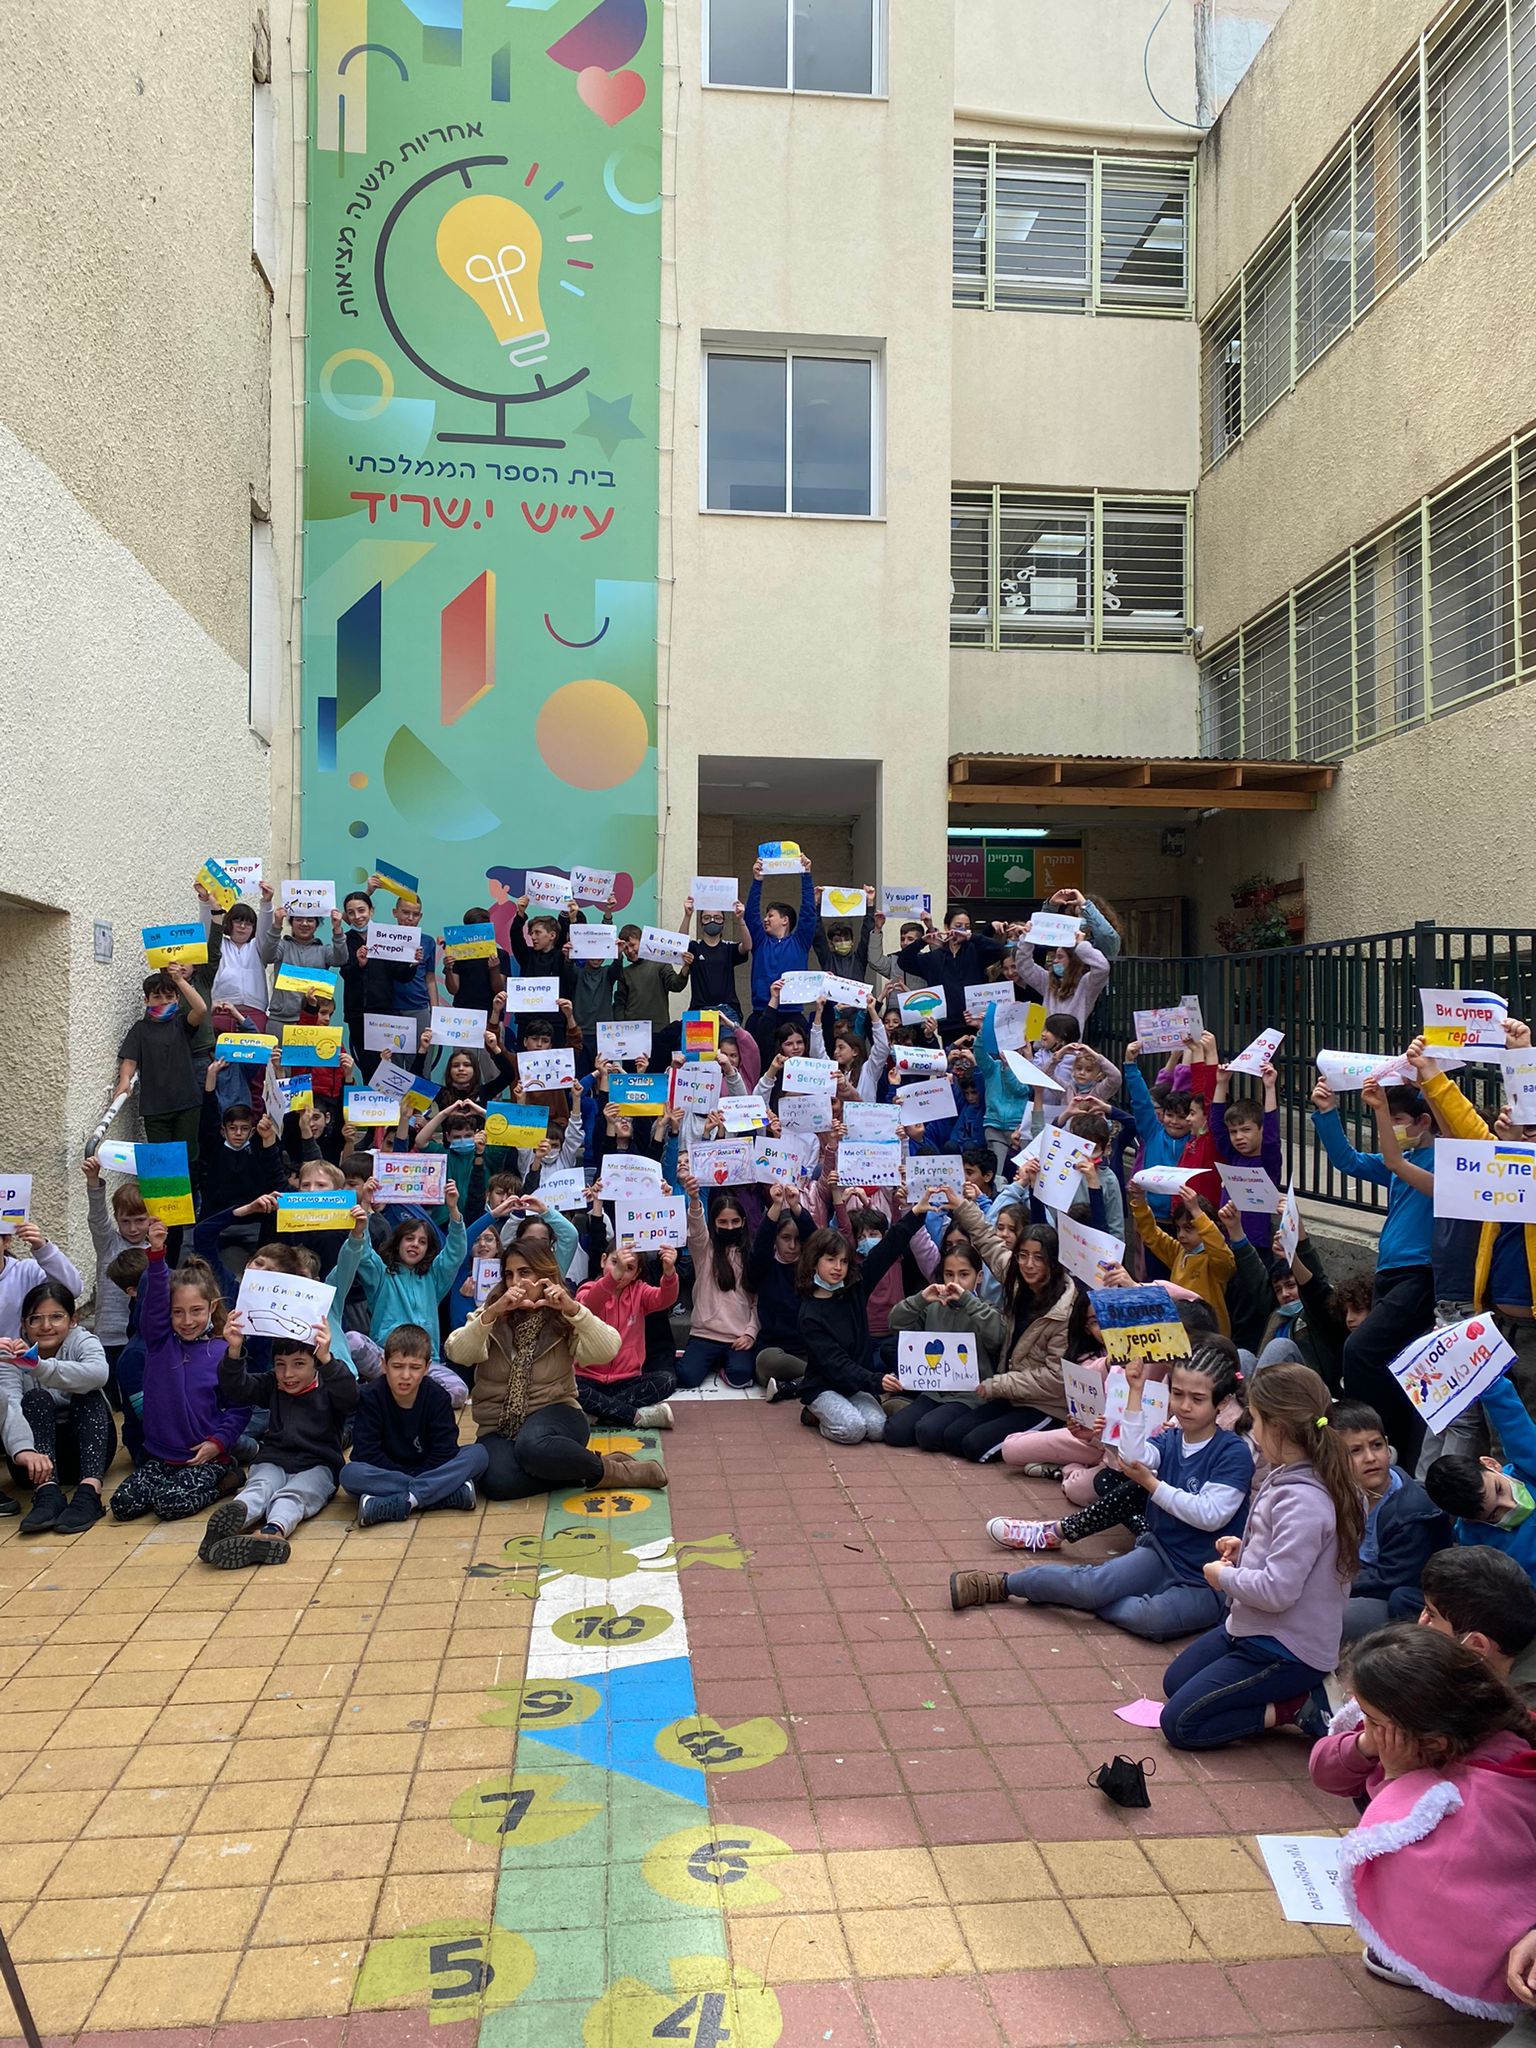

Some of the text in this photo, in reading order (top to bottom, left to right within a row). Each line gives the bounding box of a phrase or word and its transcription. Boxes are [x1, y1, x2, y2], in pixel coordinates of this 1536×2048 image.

[334, 121, 485, 318] אחריות משנה מציאות
[348, 453, 616, 487] בית הספר הממלכתי
[988, 854, 1023, 863] תדמיינו
[1043, 855, 1075, 867] תחקרו
[530, 879, 542, 889] Vy
[575, 872, 612, 885] Vy super
[303, 888, 327, 897] супер
[696, 884, 708, 893] Vy
[885, 892, 919, 902] Vy super
[376, 930, 412, 942] Ви супер
[515, 984, 551, 995] Ви супер
[1436, 1003, 1493, 1021] Ви супер
[440, 1015, 478, 1028] Ви супер
[1447, 1029, 1480, 1045] герої
[789, 1059, 801, 1067] Vy
[677, 1078, 715, 1092] Ви супер
[354, 1093, 394, 1107] Ви супер
[765, 1147, 778, 1158] Ви
[385, 1163, 436, 1176] Ви супер
[914, 1166, 954, 1178] Ви супер
[1456, 1157, 1481, 1173] Ви
[395, 1181, 424, 1192] герої
[548, 1178, 576, 1189] супер
[1473, 1189, 1526, 1206] герої
[627, 1208, 676, 1222] Ви супер
[639, 1226, 667, 1240] герої
[484, 1269, 498, 1279] Ви
[1126, 1327, 1163, 1353] герої
[1424, 1331, 1459, 1372] герої
[1432, 1344, 1492, 1403] Ви супер
[574, 1615, 646, 1640] 10
[520, 1690, 574, 1720] 9
[677, 1729, 744, 1765] 8
[480, 1789, 536, 1834] 7
[687, 1839, 752, 1886] 6
[429, 1937, 496, 2001] 5
[652, 1992, 732, 2048] 4
